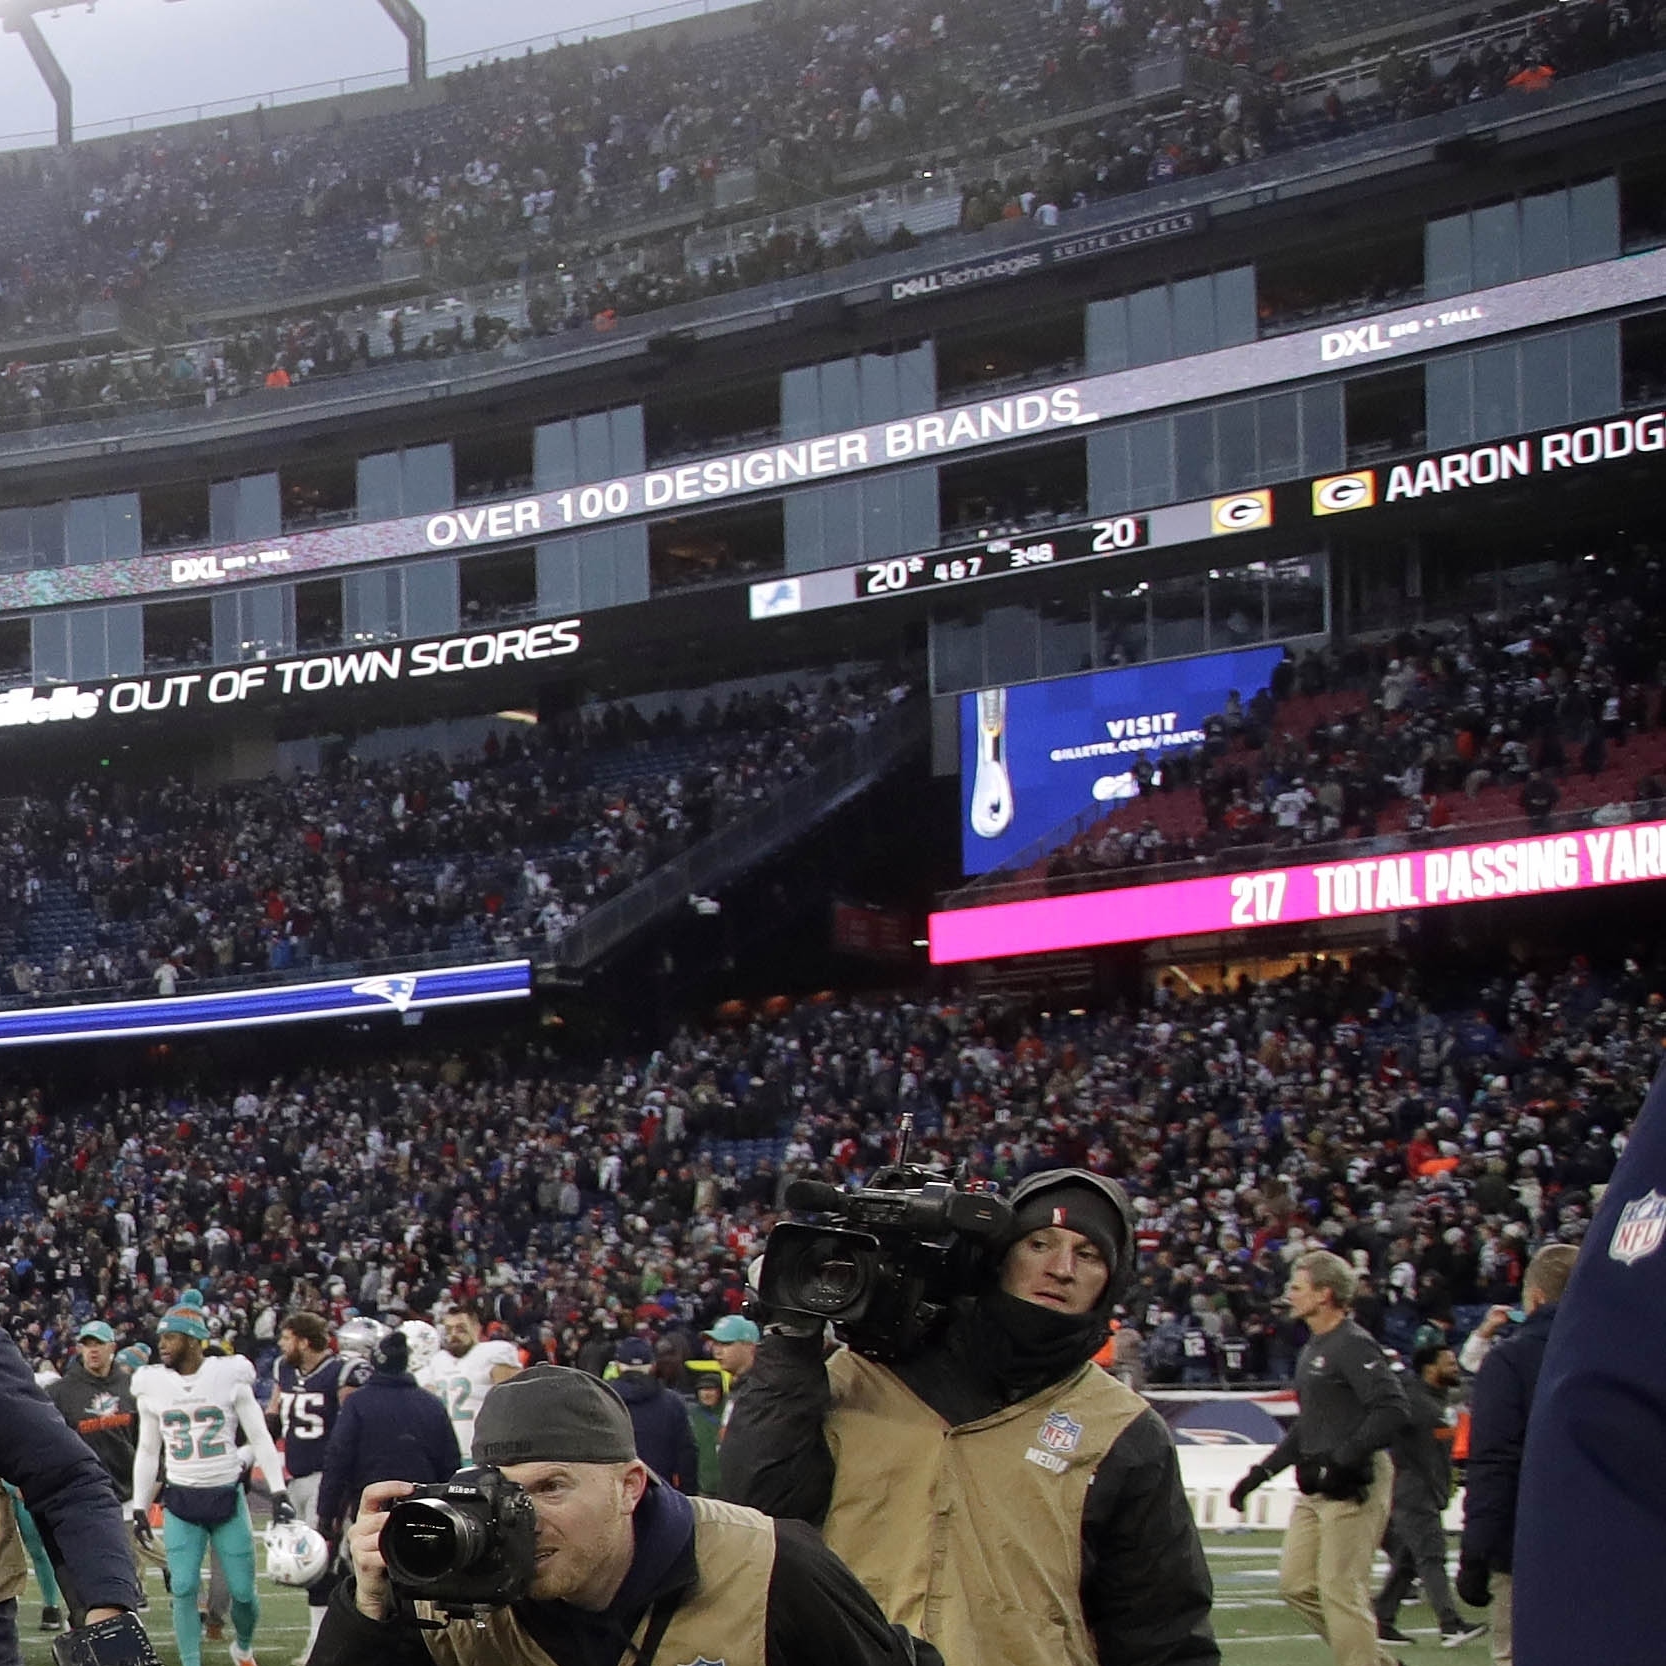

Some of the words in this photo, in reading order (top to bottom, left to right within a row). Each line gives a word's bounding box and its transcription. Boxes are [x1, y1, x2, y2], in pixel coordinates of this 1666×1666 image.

[892, 275, 941, 300] DELL
[941, 253, 1040, 286] Technologies
[1321, 324, 1393, 361] DXL
[1439, 306, 1483, 326] TALL
[426, 499, 541, 547] OVER
[557, 482, 630, 524] 100
[644, 434, 869, 507] DESIGNER
[1385, 441, 1531, 502] AARON
[1092, 518, 1136, 552] 20
[172, 556, 225, 582] DXL
[109, 676, 201, 715] OUT
[208, 667, 268, 703] OF
[278, 650, 402, 696] TOWN
[409, 620, 582, 677] SCORES
[1106, 712, 1177, 739] VISIT
[1231, 873, 1286, 925] 217
[1313, 858, 1420, 915] TOTAL
[1425, 837, 1579, 902] PASSING
[1613, 1218, 1663, 1260] NFL
[163, 1406, 226, 1461] 32
[1043, 1424, 1070, 1448] NFL
[448, 1485, 477, 1494] Nikon
